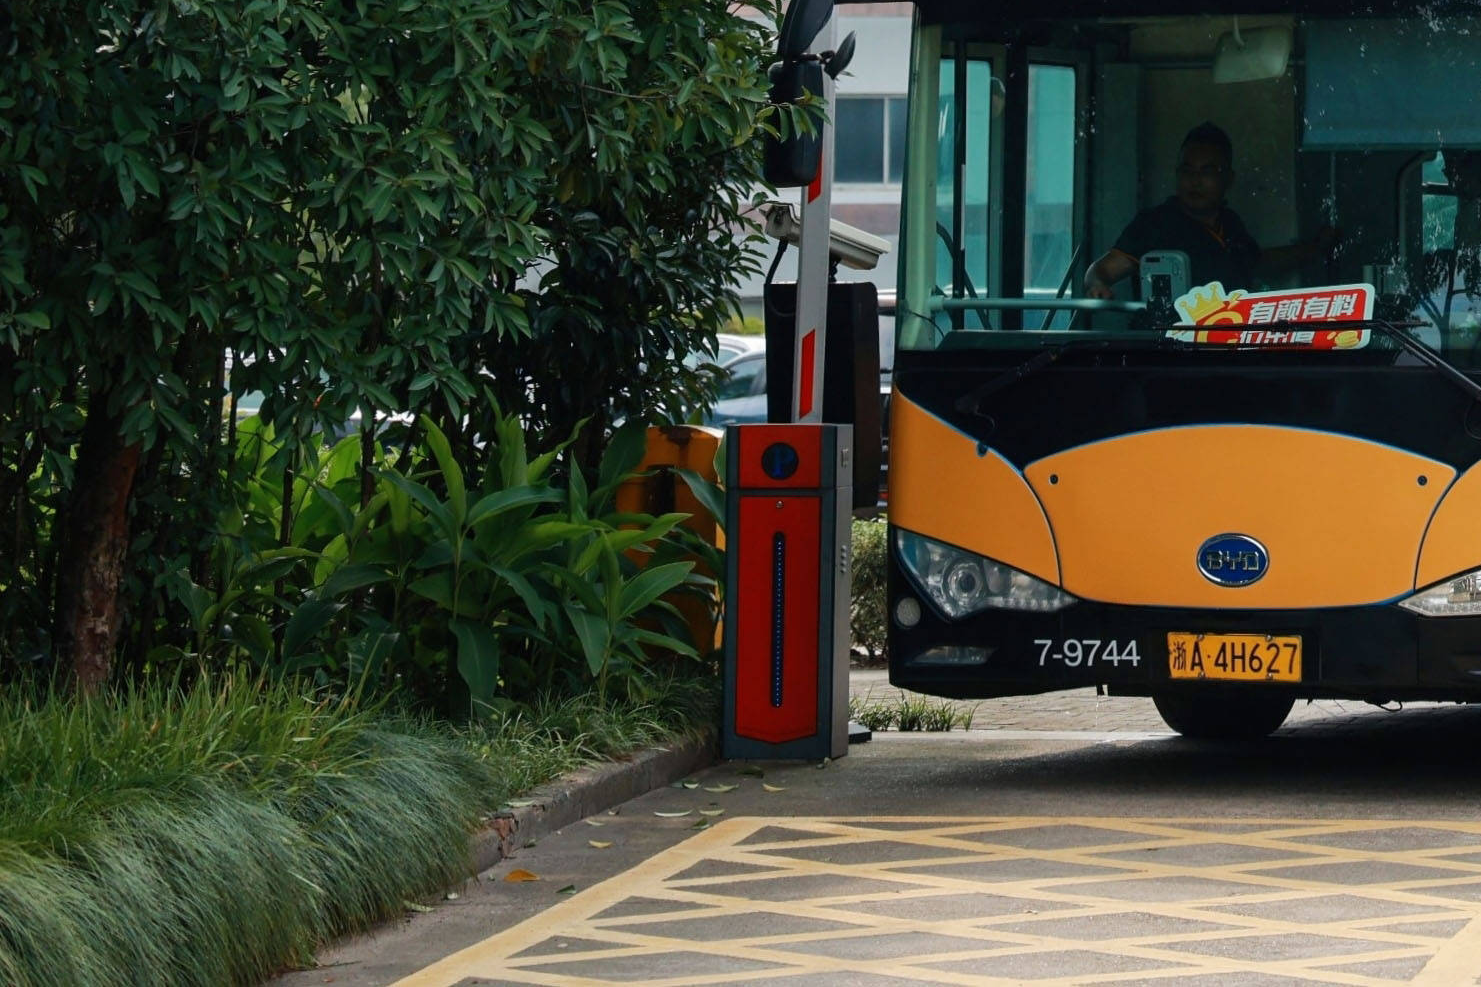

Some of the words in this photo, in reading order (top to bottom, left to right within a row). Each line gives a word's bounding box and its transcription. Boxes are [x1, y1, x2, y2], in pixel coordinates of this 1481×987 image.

[1247, 293, 1358, 325] 有颜有料
[1033, 638, 1142, 668] 7-9744
